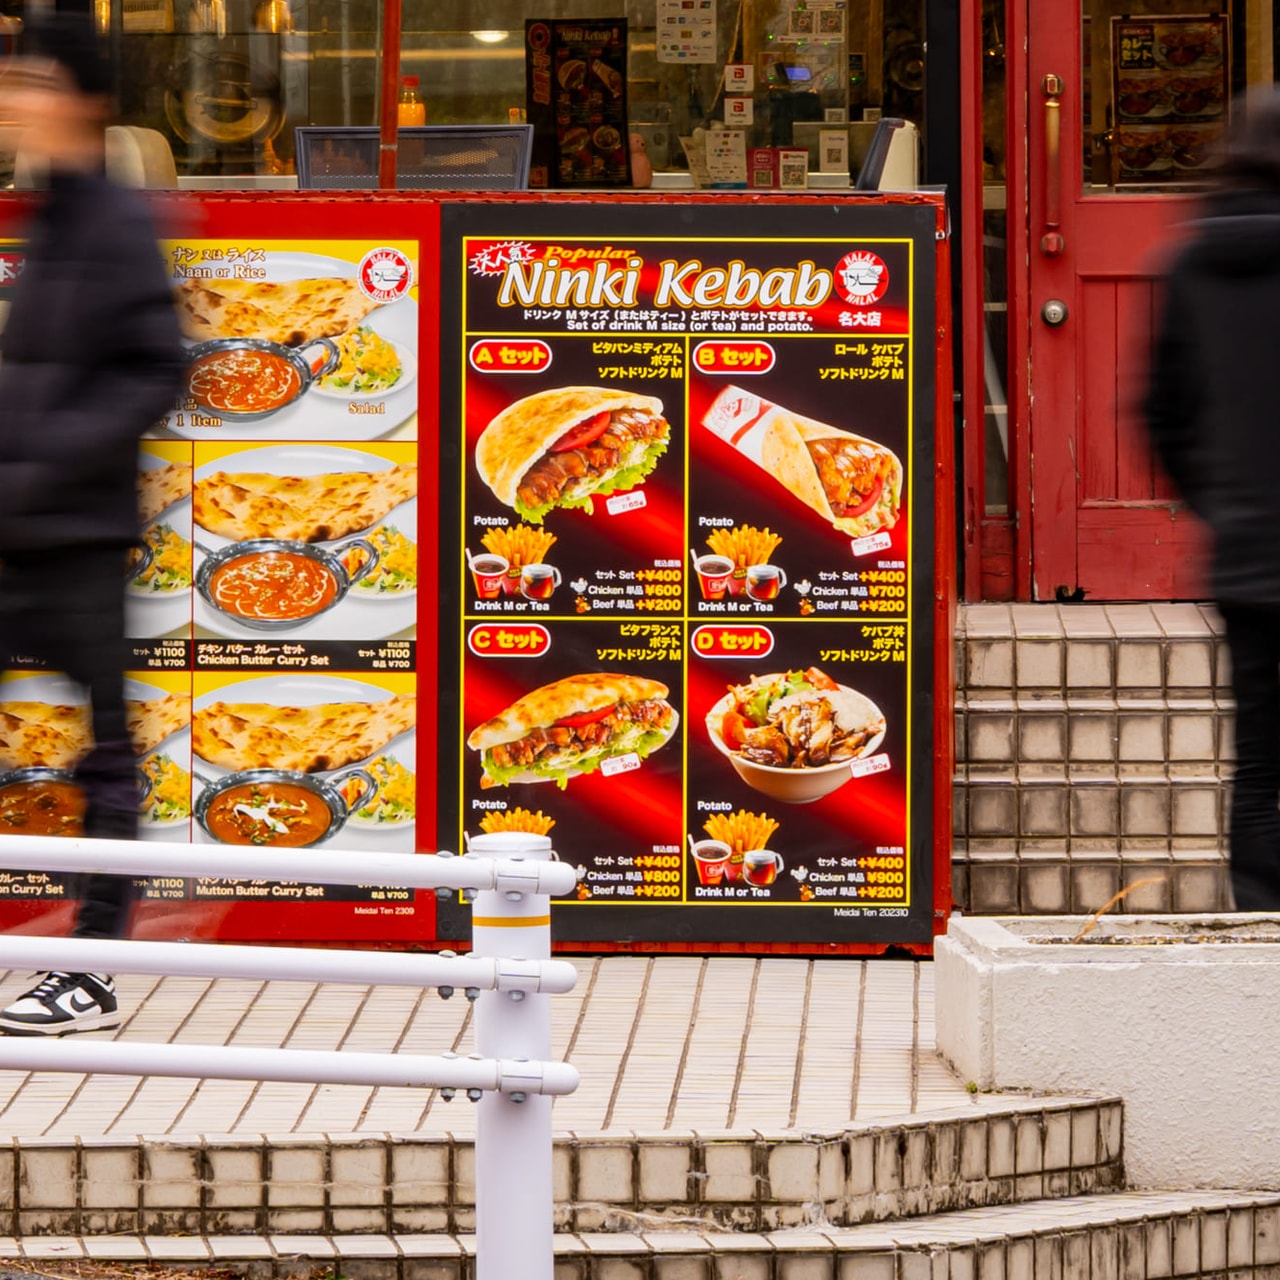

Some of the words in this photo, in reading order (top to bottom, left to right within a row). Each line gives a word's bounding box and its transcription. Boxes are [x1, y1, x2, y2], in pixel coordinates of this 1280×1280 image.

[173, 248, 197, 261] ナン
[223, 248, 266, 262] ライス
[543, 246, 635, 263] Popular
[174, 265, 211, 278] Naan
[216, 267, 229, 278] or
[234, 264, 266, 278] Rice
[499, 259, 643, 308] Ninki
[654, 260, 832, 308] Kebab
[567, 320, 588, 331] Set
[610, 320, 642, 330] drink
[662, 320, 685, 331] size
[741, 320, 764, 331] and
[838, 312, 880, 326] 名大店
[499, 346, 546, 365] セット
[835, 344, 867, 355] ロール
[721, 347, 768, 366] セット
[348, 402, 385, 415] Salad
[474, 516, 509, 526] Potato
[699, 517, 734, 526] Potato
[588, 585, 624, 595] Chicken
[645, 585, 681, 596] ¥600
[869, 586, 905, 597] ¥700
[474, 601, 501, 611] Drink
[530, 601, 550, 611] Tea
[495, 632, 543, 651] セット
[719, 633, 767, 651] セット
[197, 655, 239, 665] Chicken
[241, 656, 275, 665] Butter
[277, 656, 308, 668] Curry
[311, 656, 329, 665] Set
[644, 871, 680, 882] ¥800
[809, 873, 845, 882] Chicken
[867, 872, 903, 883] ¥900
[11, 885, 41, 896] Curry
[45, 886, 64, 895] Set
[196, 885, 233, 896] Mutton
[236, 886, 269, 896] Butter
[272, 886, 302, 898] Curry
[305, 886, 324, 896] Set
[695, 888, 722, 897] Drink
